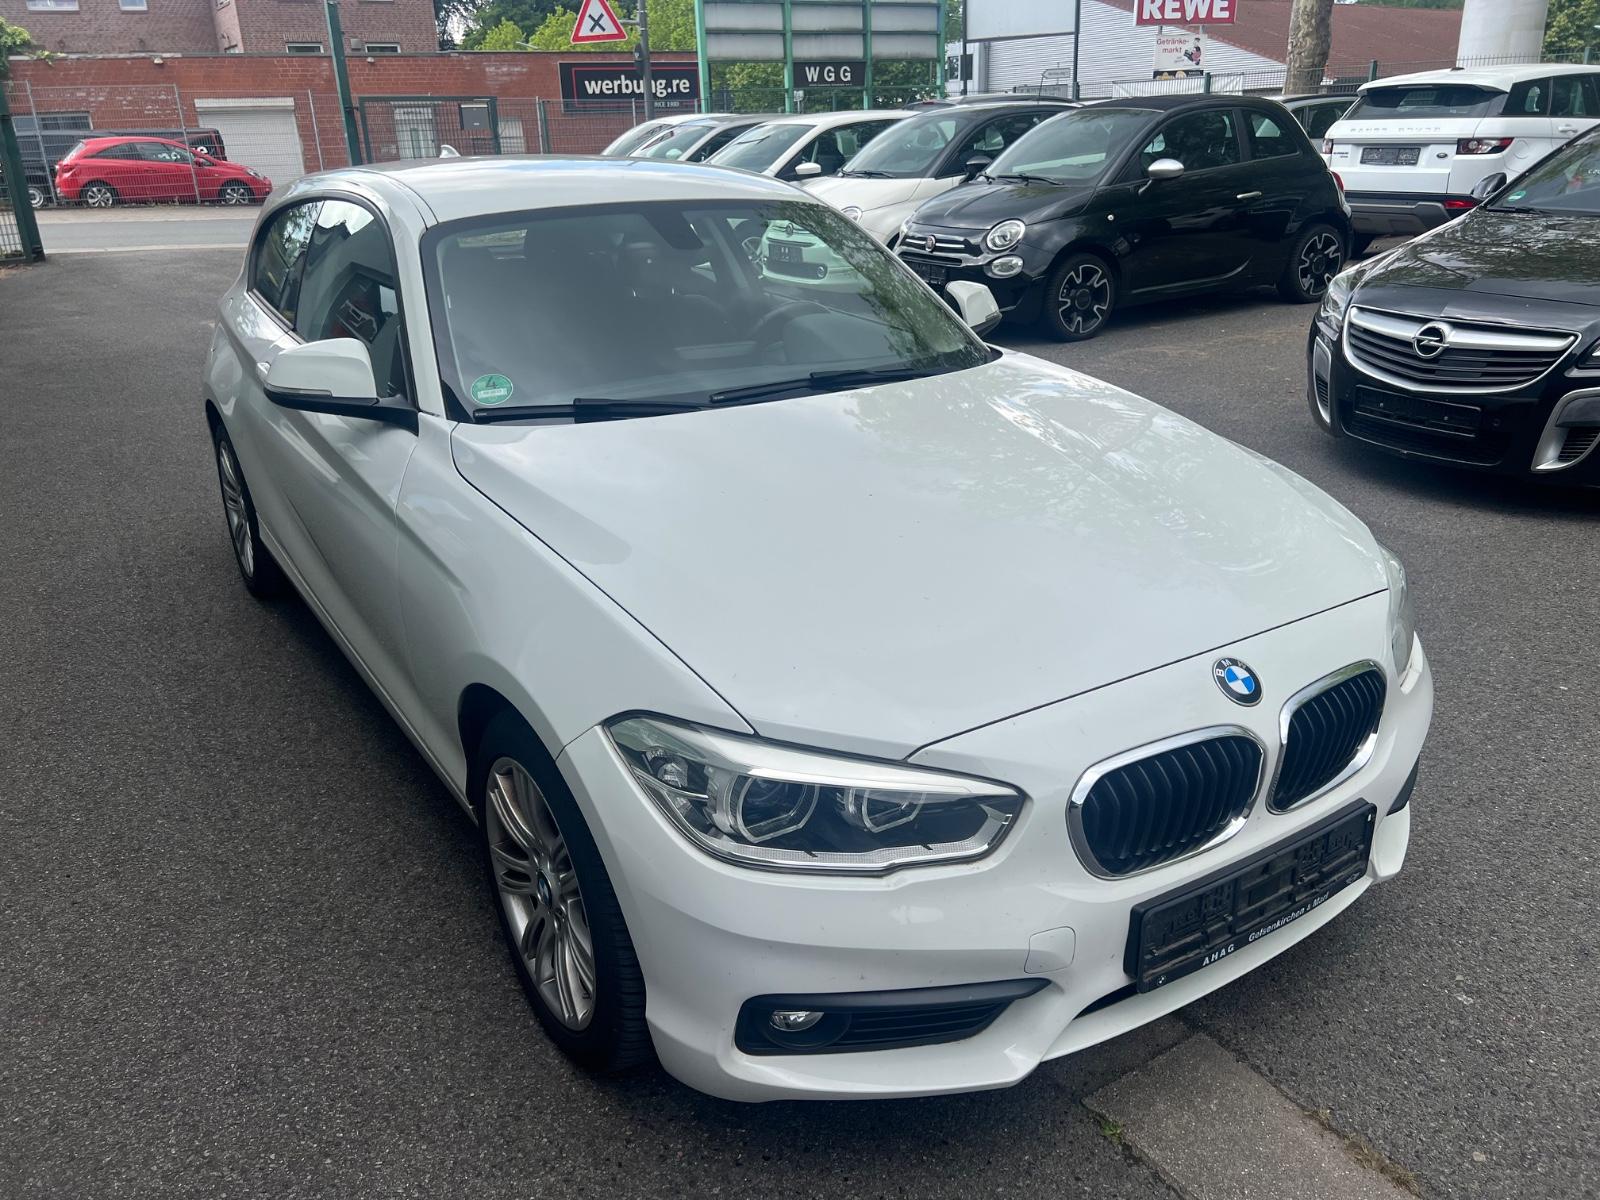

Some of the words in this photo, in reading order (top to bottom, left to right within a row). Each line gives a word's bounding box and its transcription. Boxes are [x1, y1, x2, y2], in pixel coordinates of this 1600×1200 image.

[1142, 0, 1230, 21] REWE
[485, 376, 497, 389] 4
[1215, 659, 1247, 677] BMW
[1202, 943, 1235, 967] AHAG
